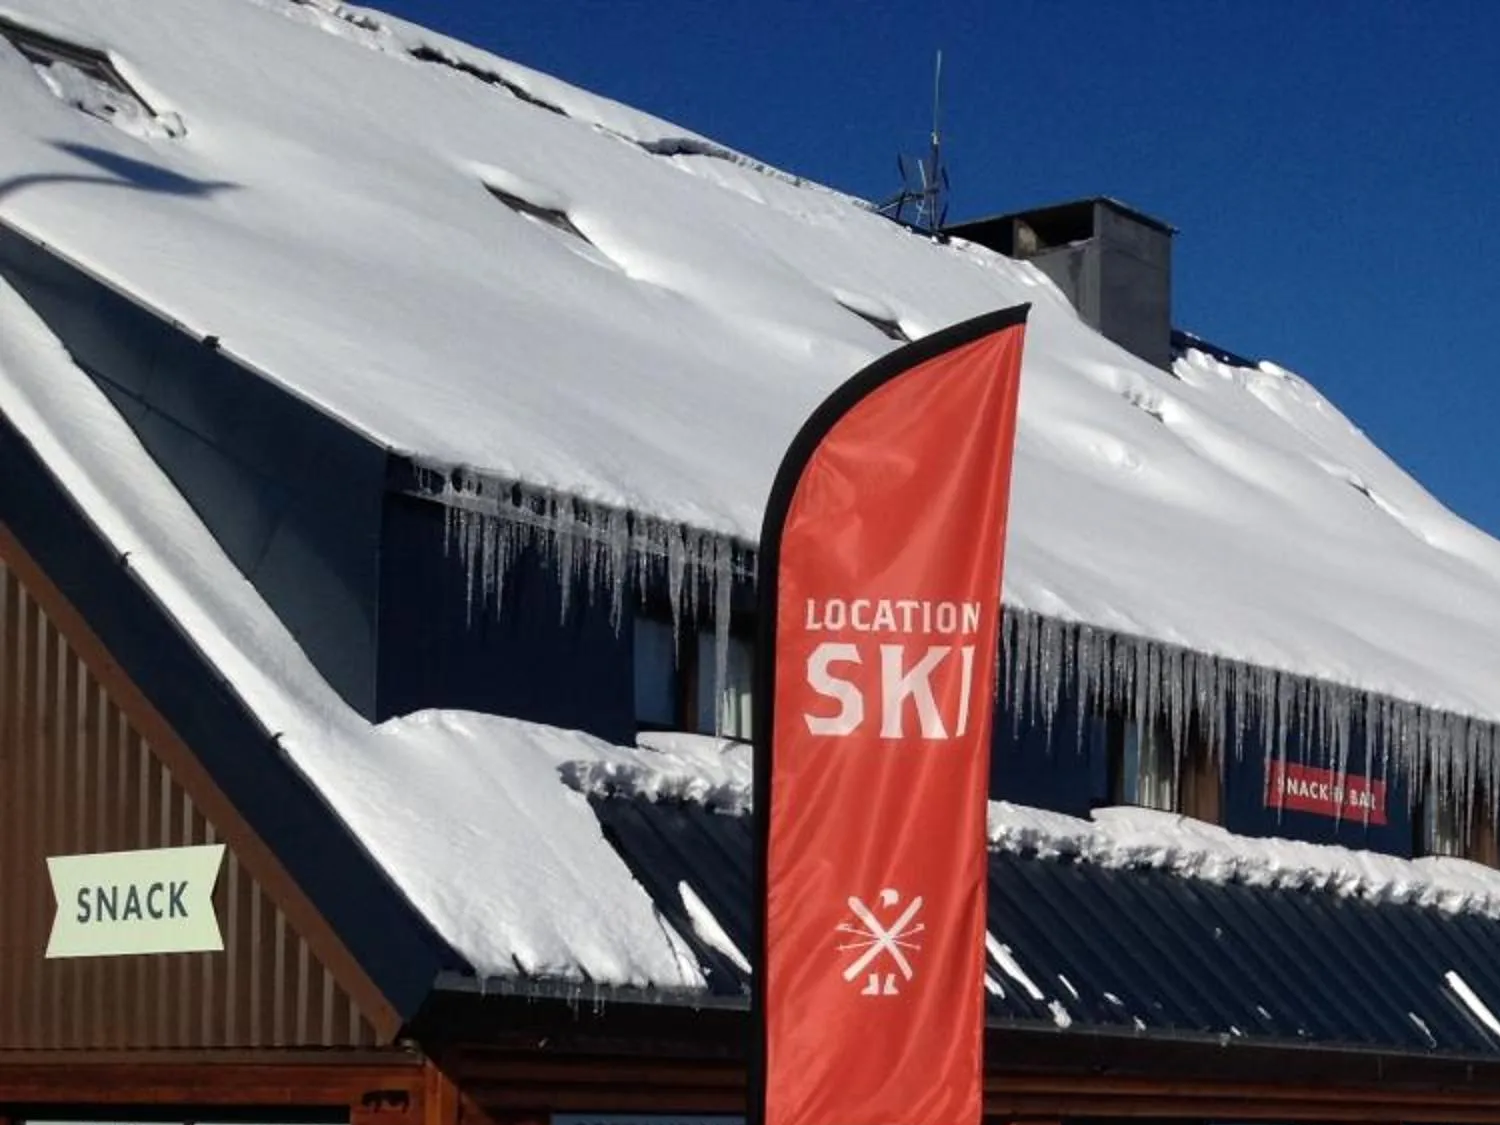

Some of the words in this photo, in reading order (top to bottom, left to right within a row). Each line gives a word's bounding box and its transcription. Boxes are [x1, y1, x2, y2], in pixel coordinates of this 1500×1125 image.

[805, 599, 980, 634] LOCATION
[804, 642, 976, 739] SKI
[76, 881, 190, 923] SNACK
